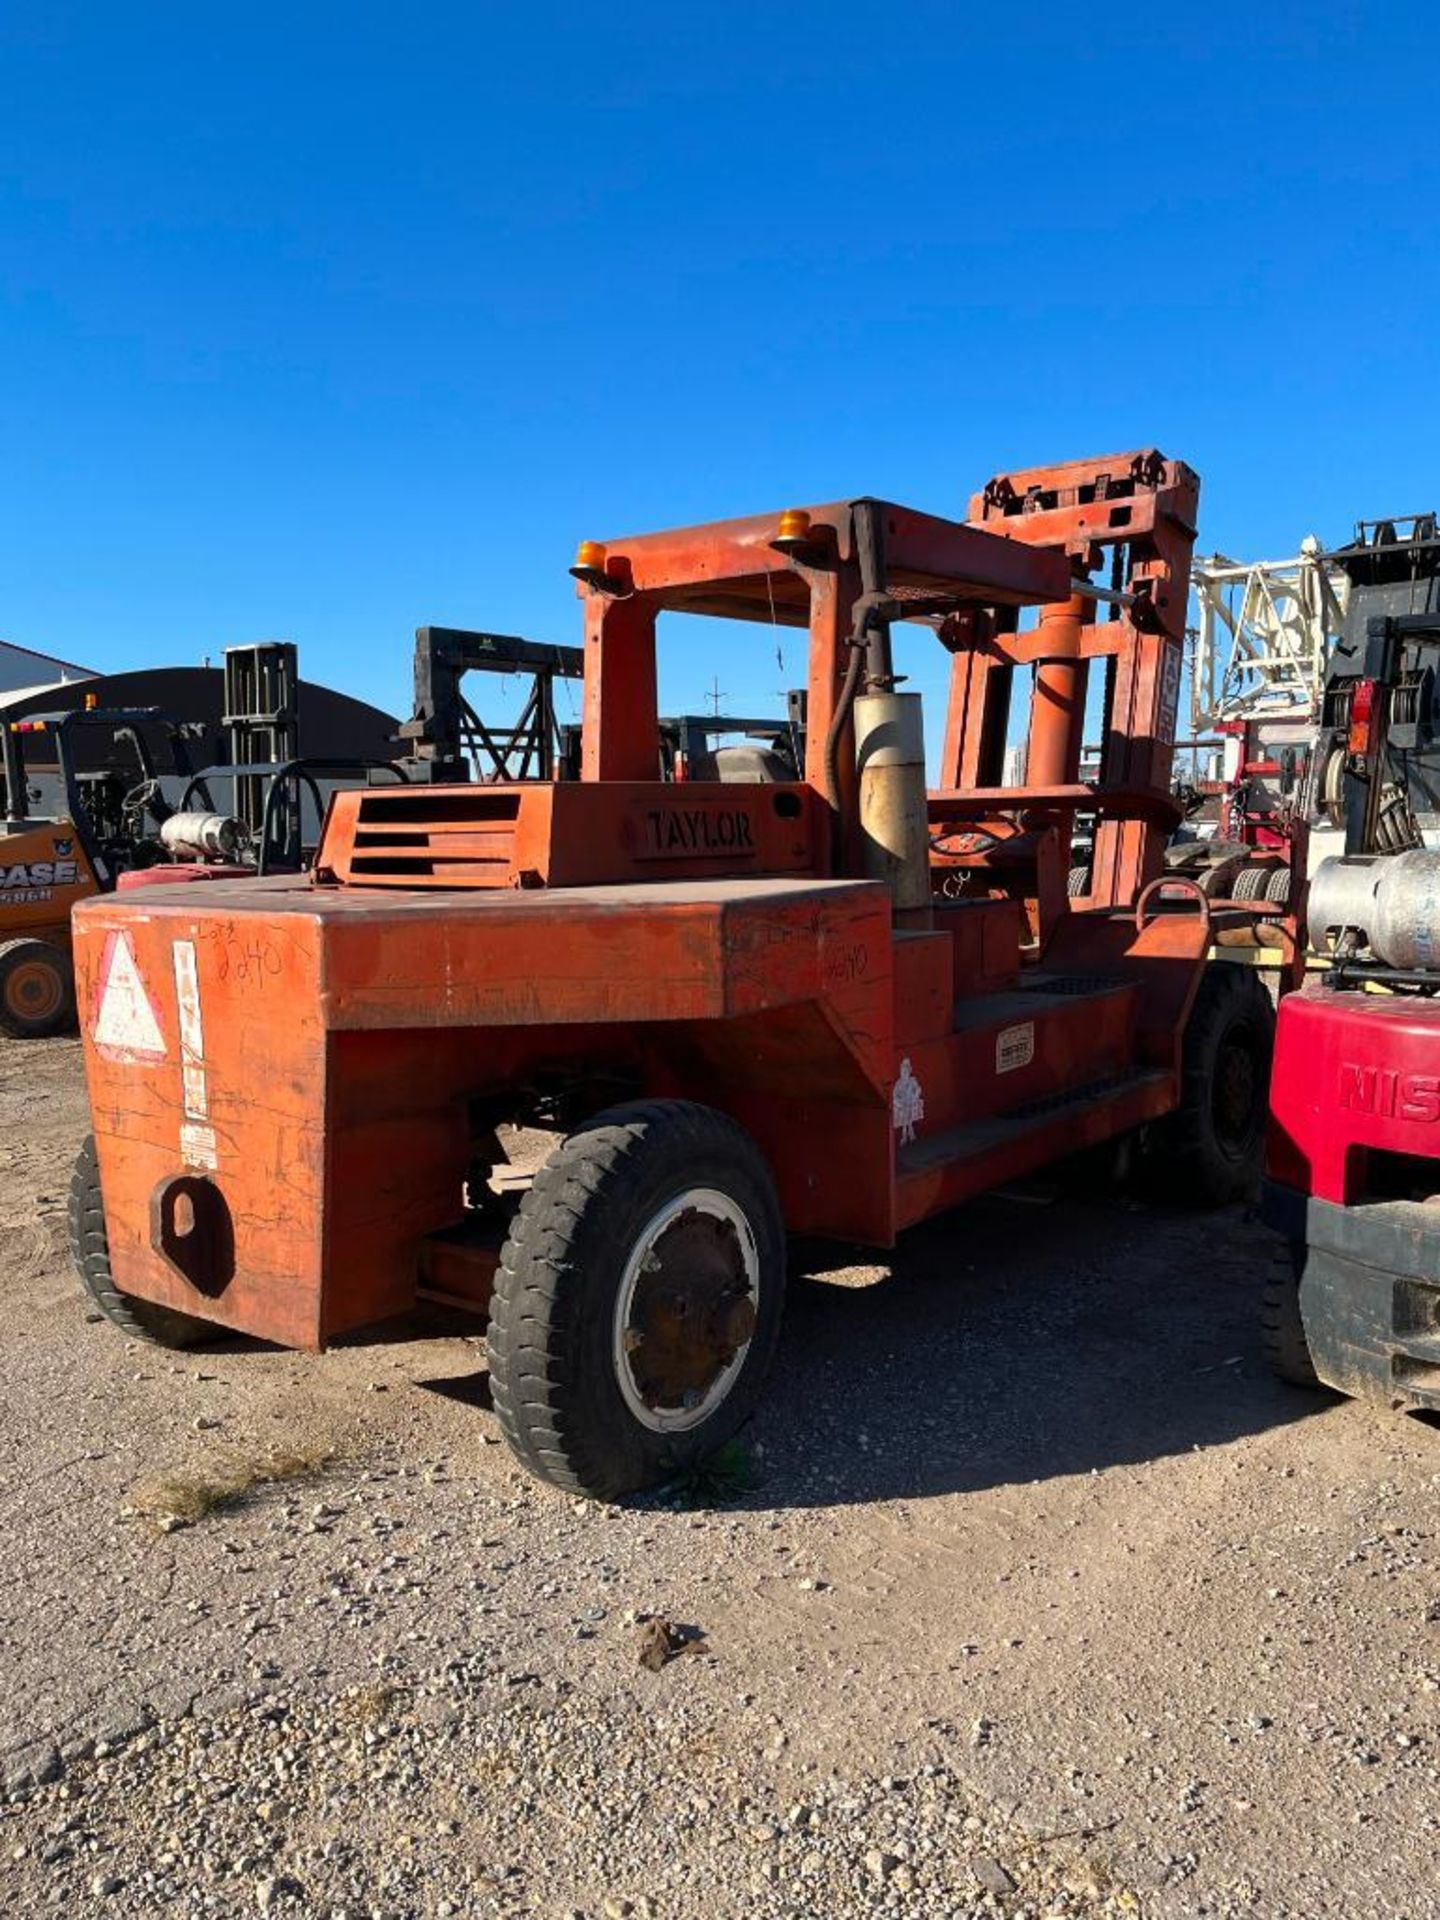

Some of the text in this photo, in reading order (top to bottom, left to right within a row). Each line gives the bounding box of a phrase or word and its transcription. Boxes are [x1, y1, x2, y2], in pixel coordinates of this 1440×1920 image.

[647, 809, 754, 850] TAYLOR
[0, 861, 77, 889] ASE
[213, 938, 283, 990] 2240
